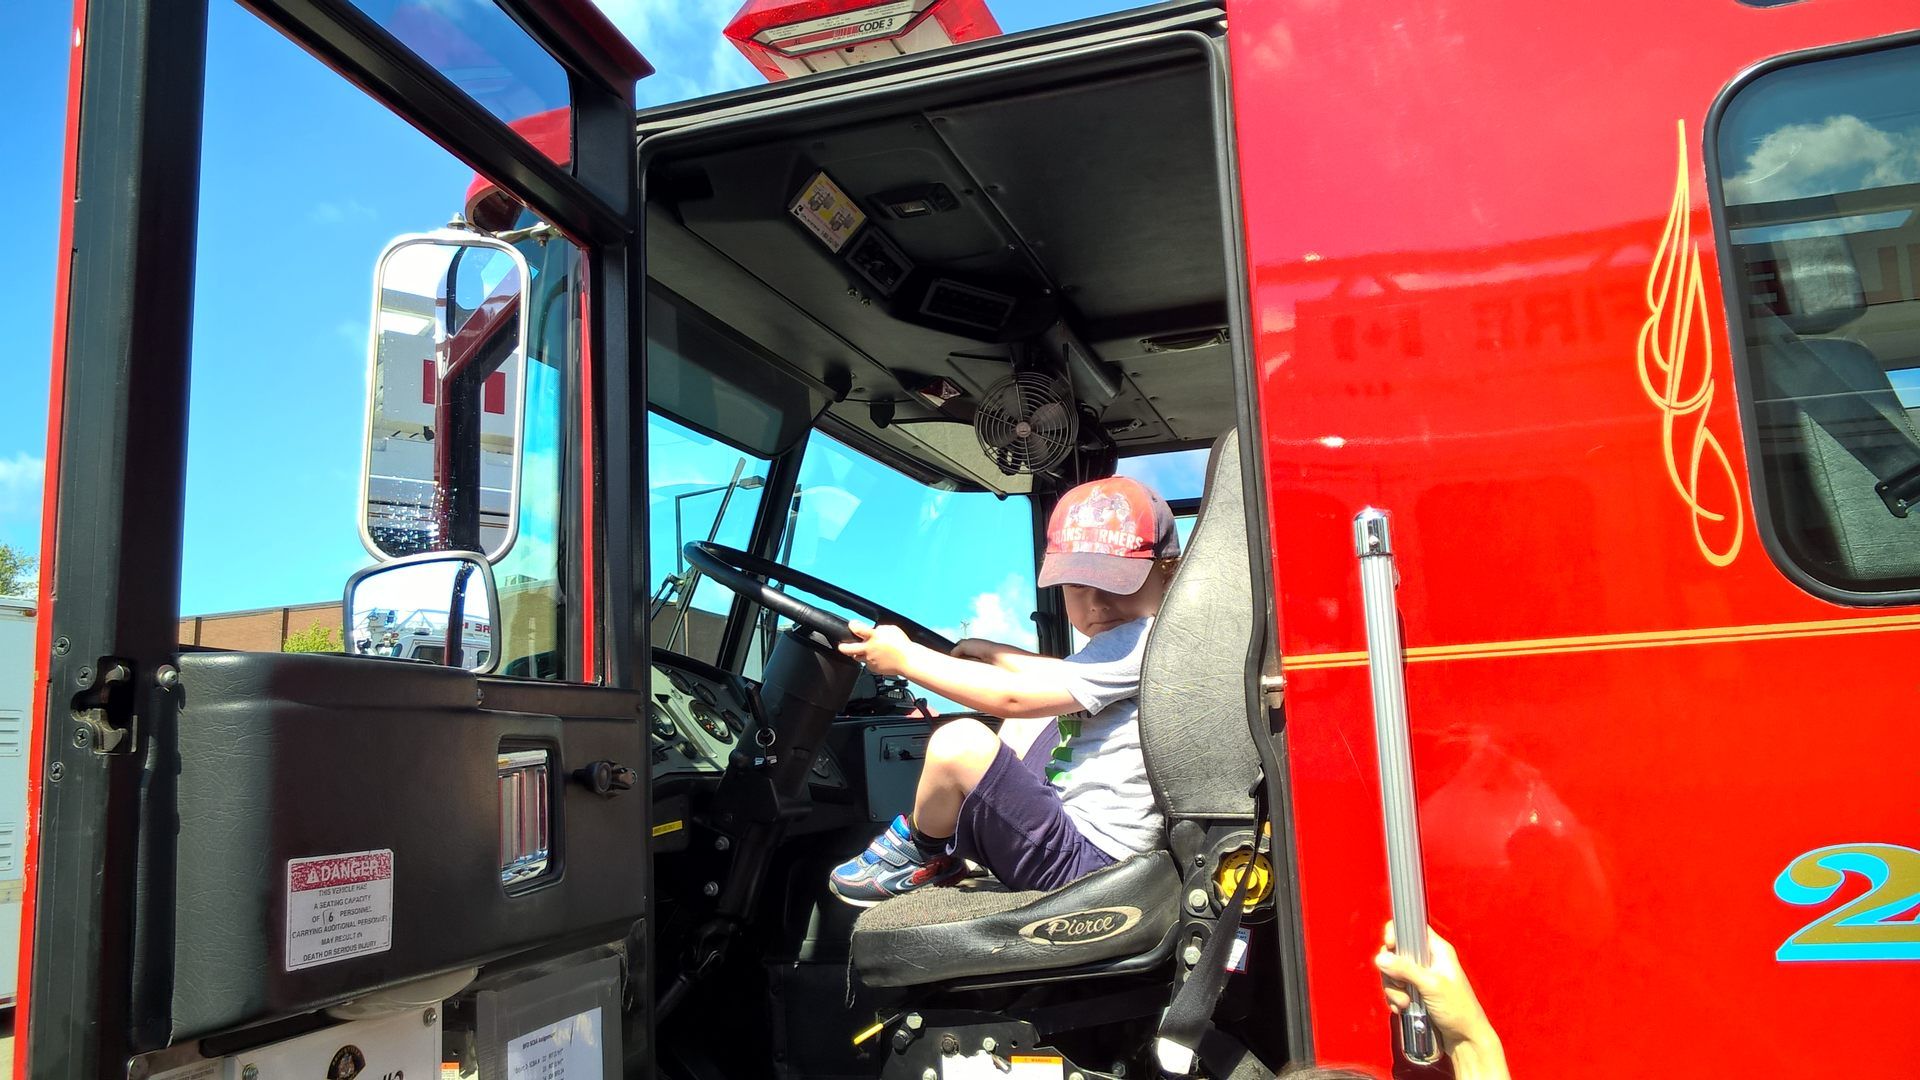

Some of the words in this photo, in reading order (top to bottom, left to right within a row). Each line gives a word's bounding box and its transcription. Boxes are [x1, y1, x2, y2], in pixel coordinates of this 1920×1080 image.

[858, 19, 886, 33] CODE
[887, 18, 893, 27] 3
[321, 858, 379, 882] DANGER
[319, 889, 331, 897] THIS
[333, 885, 356, 895] VEHICLE
[319, 899, 344, 909] SEATING
[344, 894, 371, 905] CAPACITY
[312, 915, 321, 923] OF
[340, 906, 372, 917] PERSONNEL
[292, 927, 323, 939] CARRYING
[324, 922, 356, 933] ADDITIONAL
[357, 915, 388, 926] PERSONNEL
[1046, 916, 1115, 936] Pierce
[321, 937, 334, 945] MAY
[335, 934, 356, 942] RESULT
[303, 952, 323, 962] DEATH
[333, 944, 358, 955] SERIOUS
[358, 940, 377, 950] INJURY
